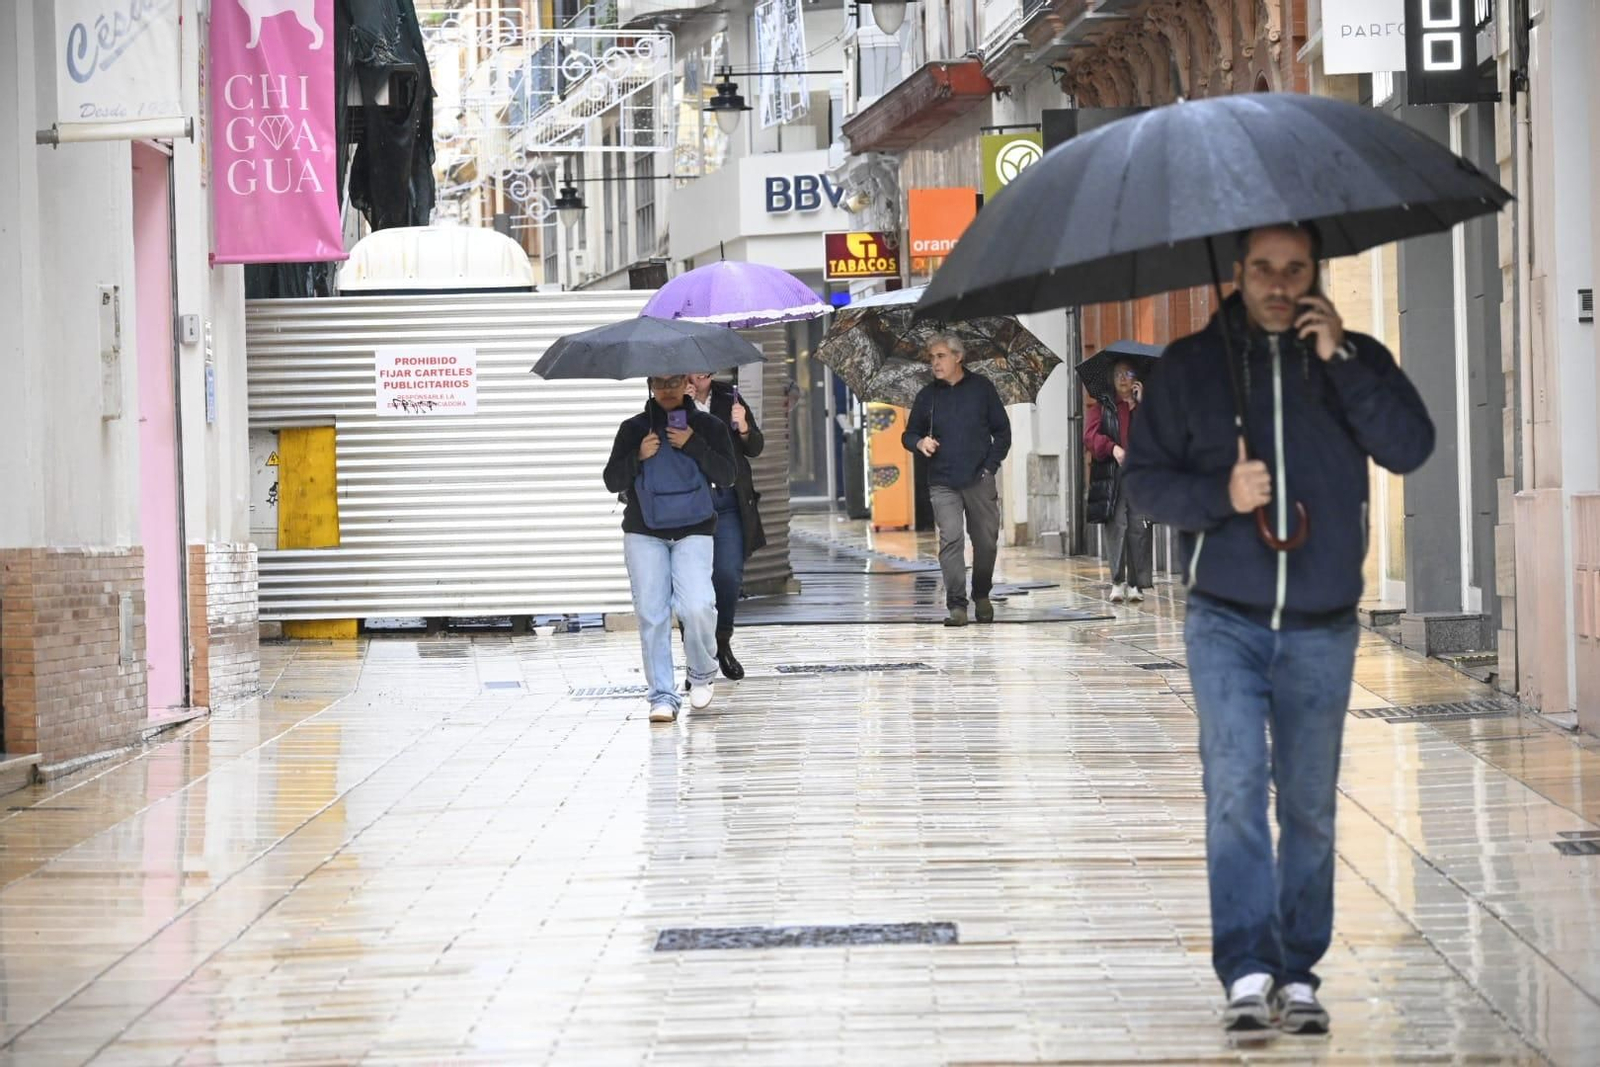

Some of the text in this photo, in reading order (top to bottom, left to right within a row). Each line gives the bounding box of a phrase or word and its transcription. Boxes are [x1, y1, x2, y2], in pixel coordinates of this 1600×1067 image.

[223, 74, 309, 111] CHI
[79, 102, 127, 118] Desde
[226, 157, 325, 196] GUA
[829, 257, 897, 273] TABACOS
[394, 356, 457, 366] PROHIBIDO
[379, 367, 473, 378] FIJAR CARTELES
[383, 379, 469, 390] PUBLICITARIOS
